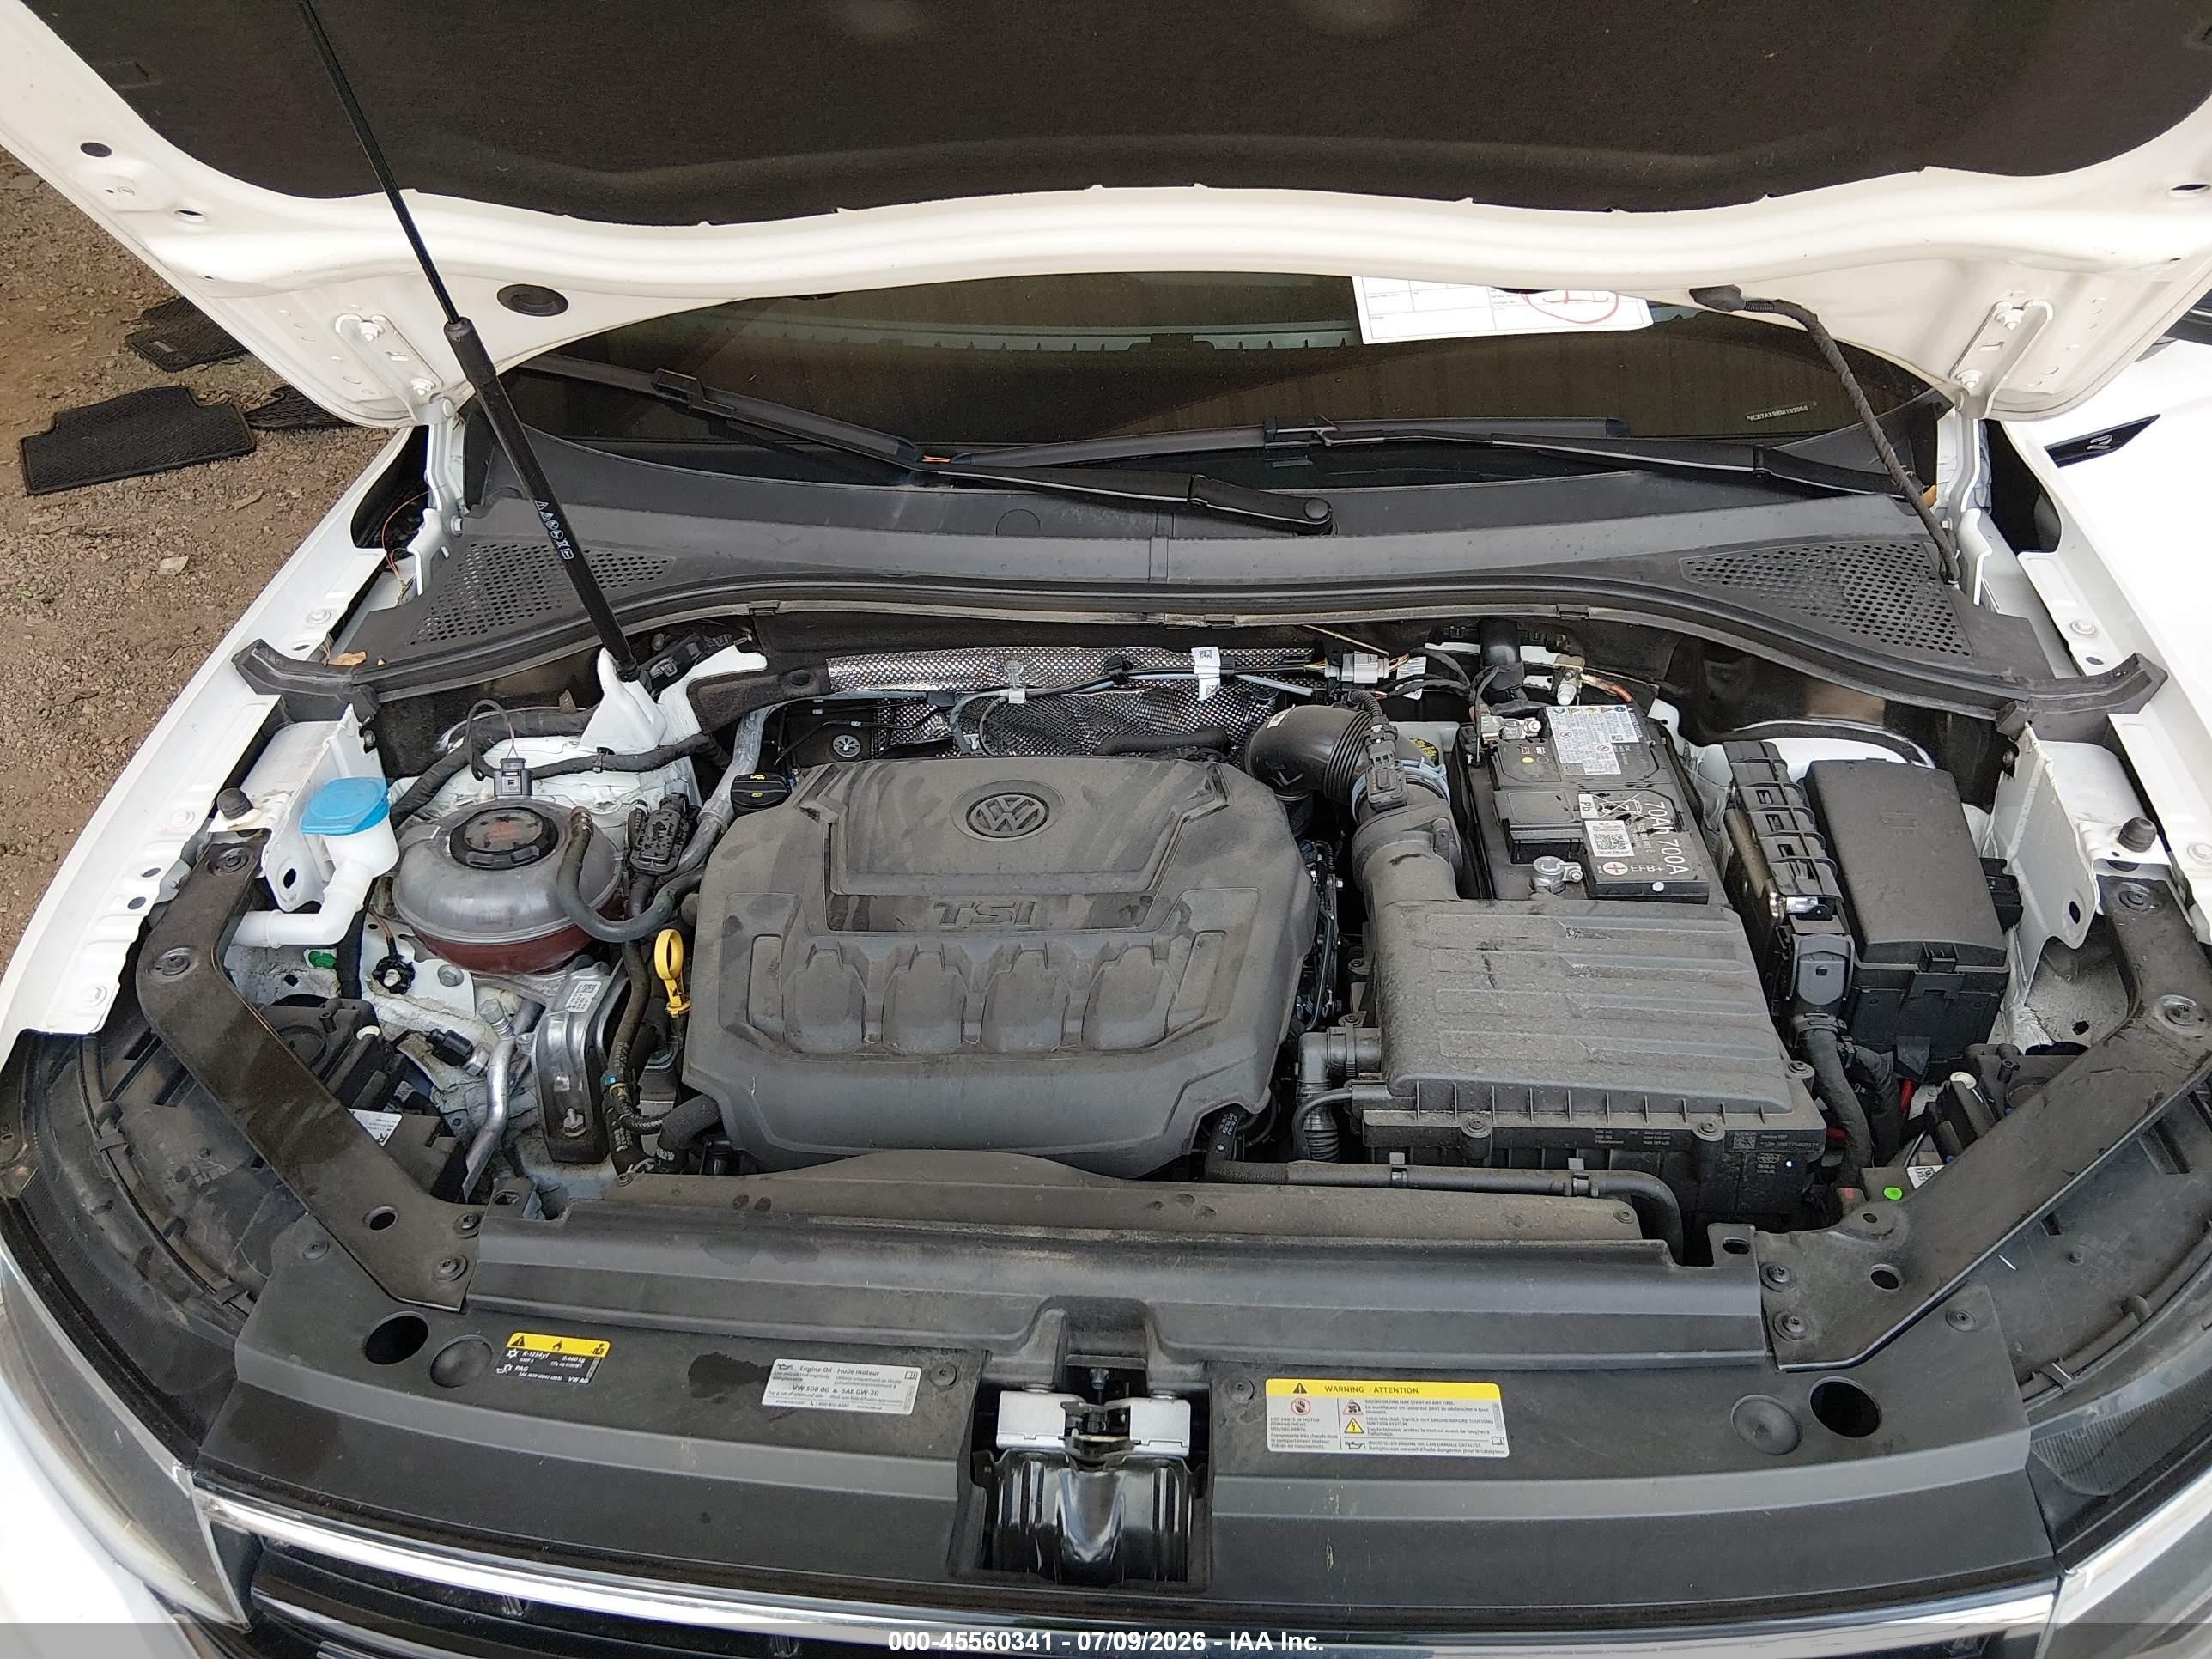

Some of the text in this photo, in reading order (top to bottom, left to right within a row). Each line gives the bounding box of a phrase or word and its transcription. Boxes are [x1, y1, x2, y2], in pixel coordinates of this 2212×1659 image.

[1580, 801, 1592, 811] Pb
[1644, 801, 1674, 835] 70Ah
[1657, 839, 1690, 875] 700A
[934, 901, 1036, 926] TSI
[522, 1351, 550, 1360] R-1234yf
[1325, 1385, 1364, 1394] WARNING
